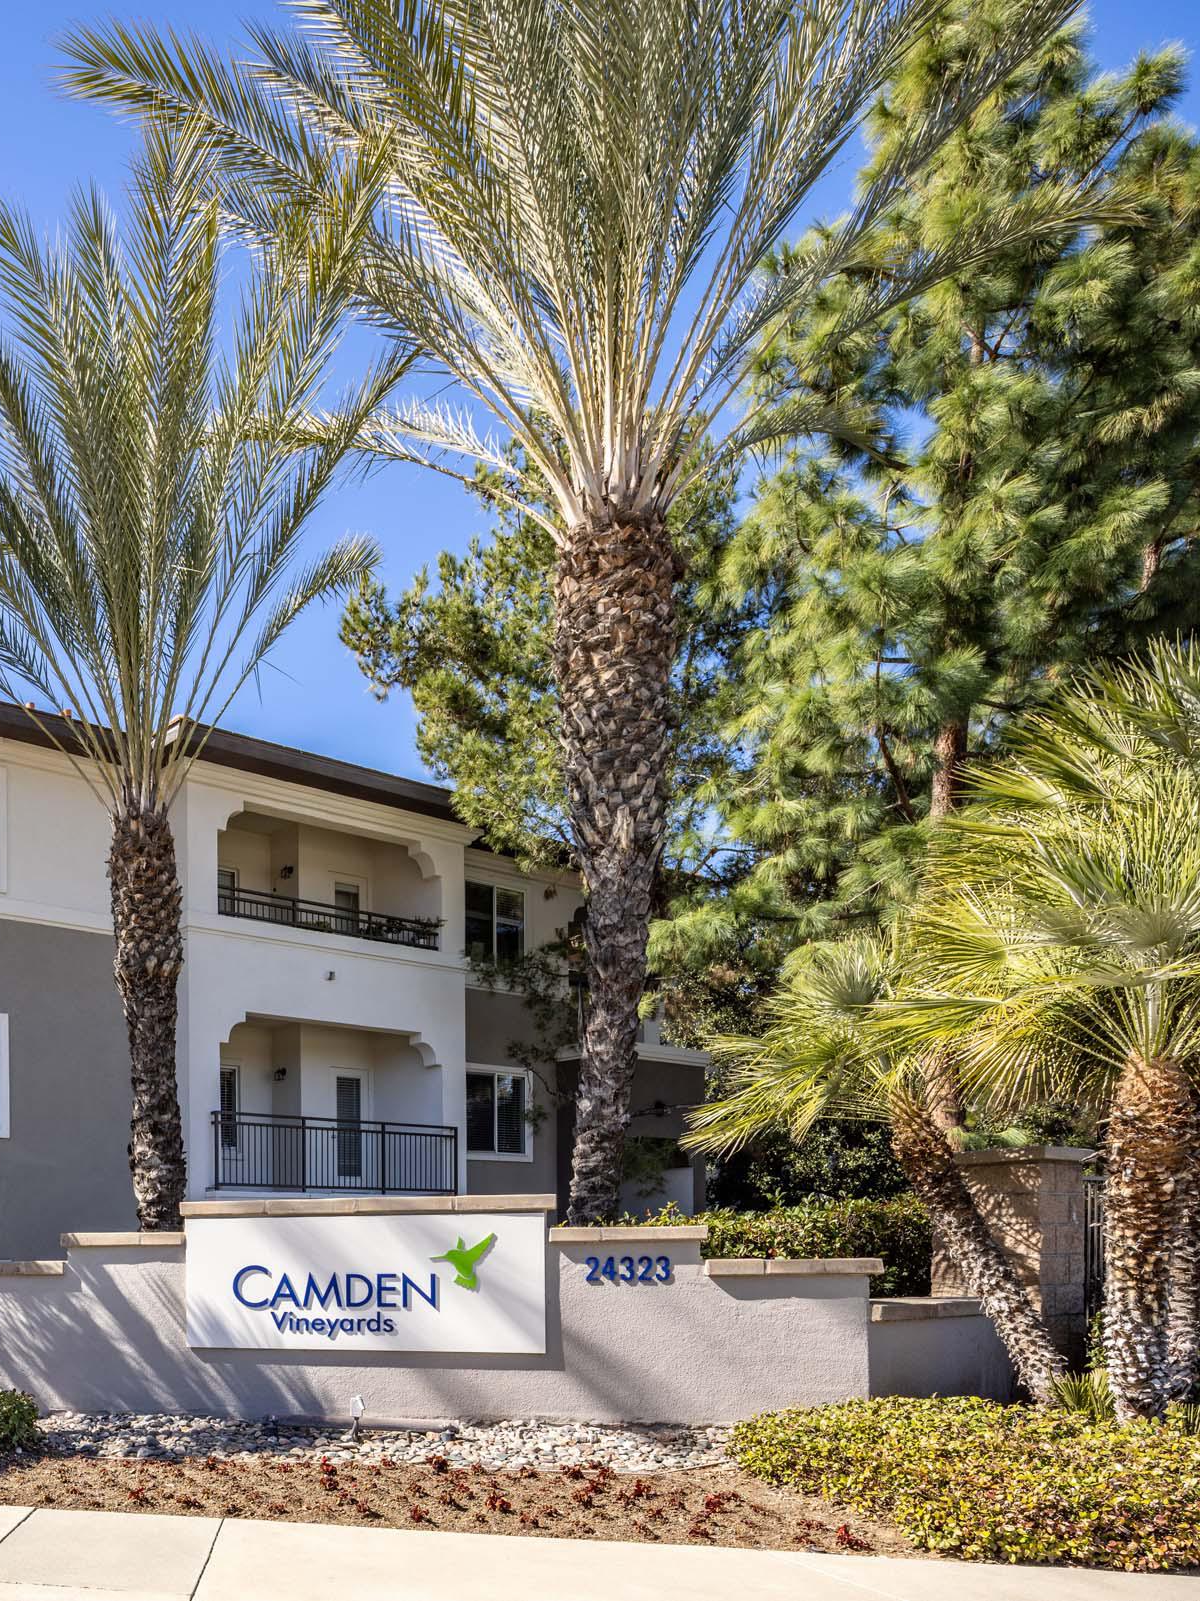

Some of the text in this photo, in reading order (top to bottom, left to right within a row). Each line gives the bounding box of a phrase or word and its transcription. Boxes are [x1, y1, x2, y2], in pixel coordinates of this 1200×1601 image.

[585, 1256, 671, 1282] 24323
[232, 1264, 438, 1311] CAMDEN
[270, 1310, 395, 1338] Vineyards
